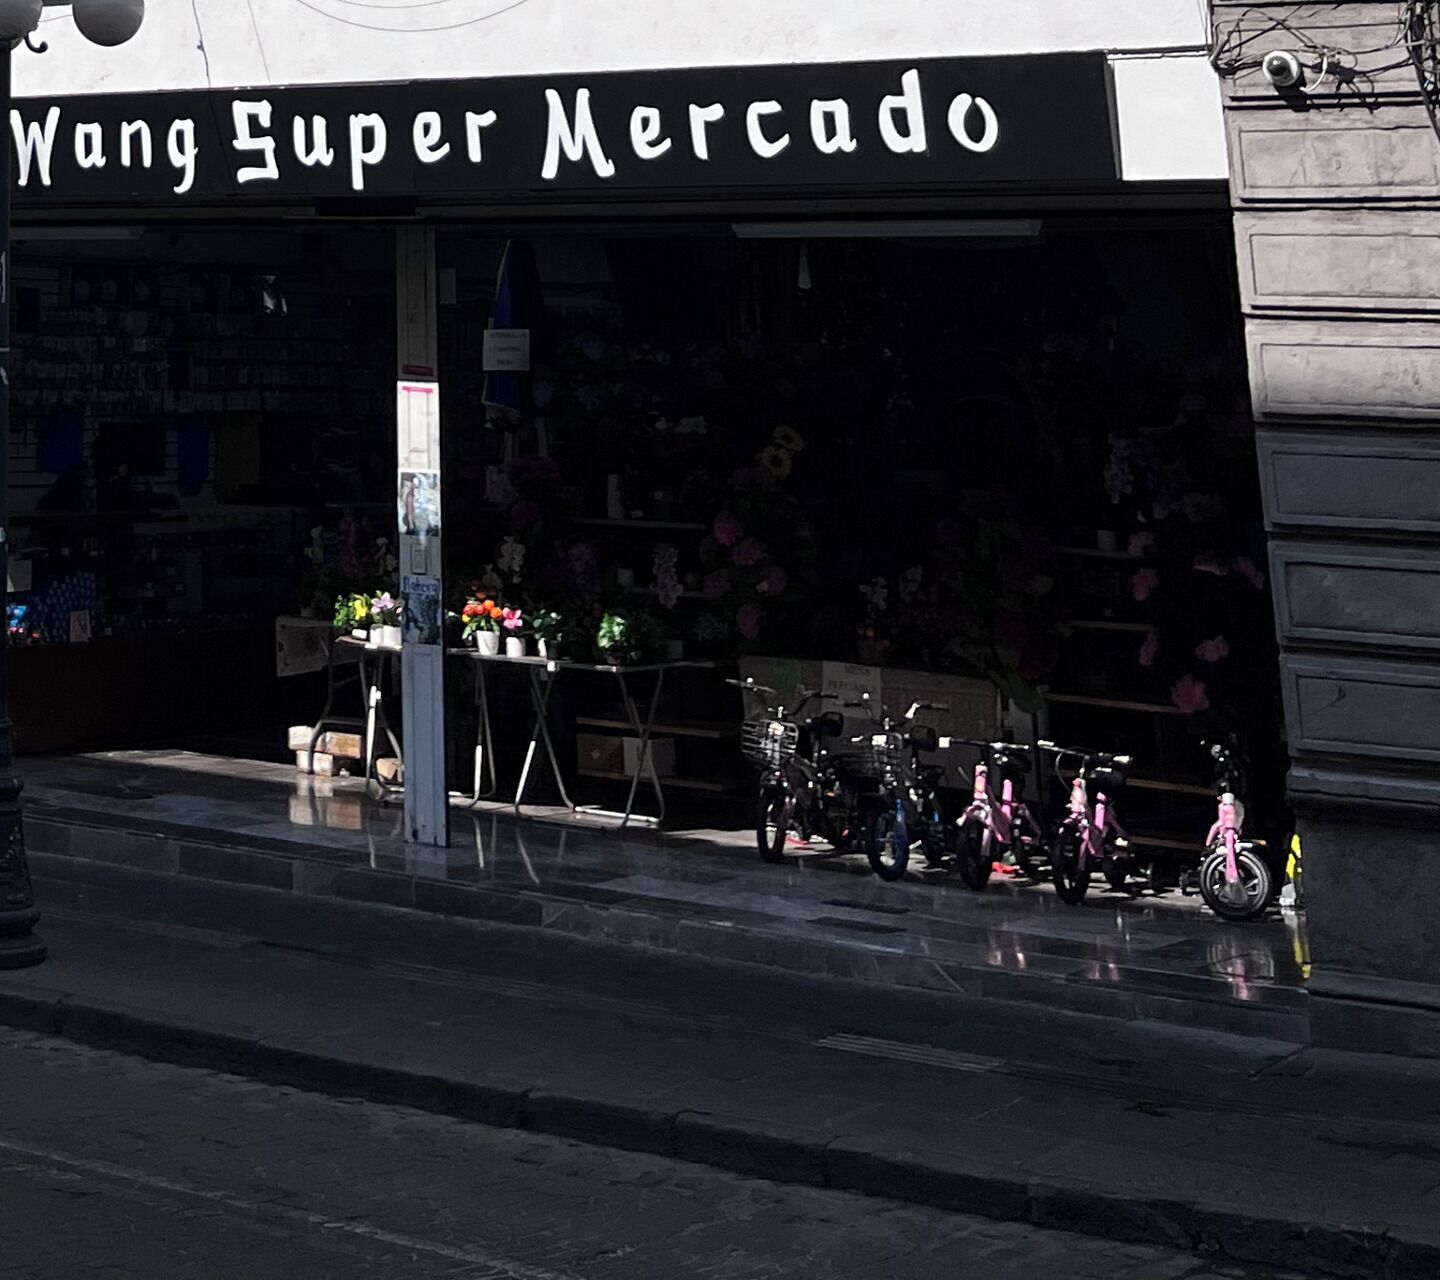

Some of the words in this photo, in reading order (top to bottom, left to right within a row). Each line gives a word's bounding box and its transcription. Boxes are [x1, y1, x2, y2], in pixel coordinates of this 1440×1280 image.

[9, 106, 199, 194] Wang
[232, 99, 497, 191] Super
[541, 68, 1000, 180] Mercado
